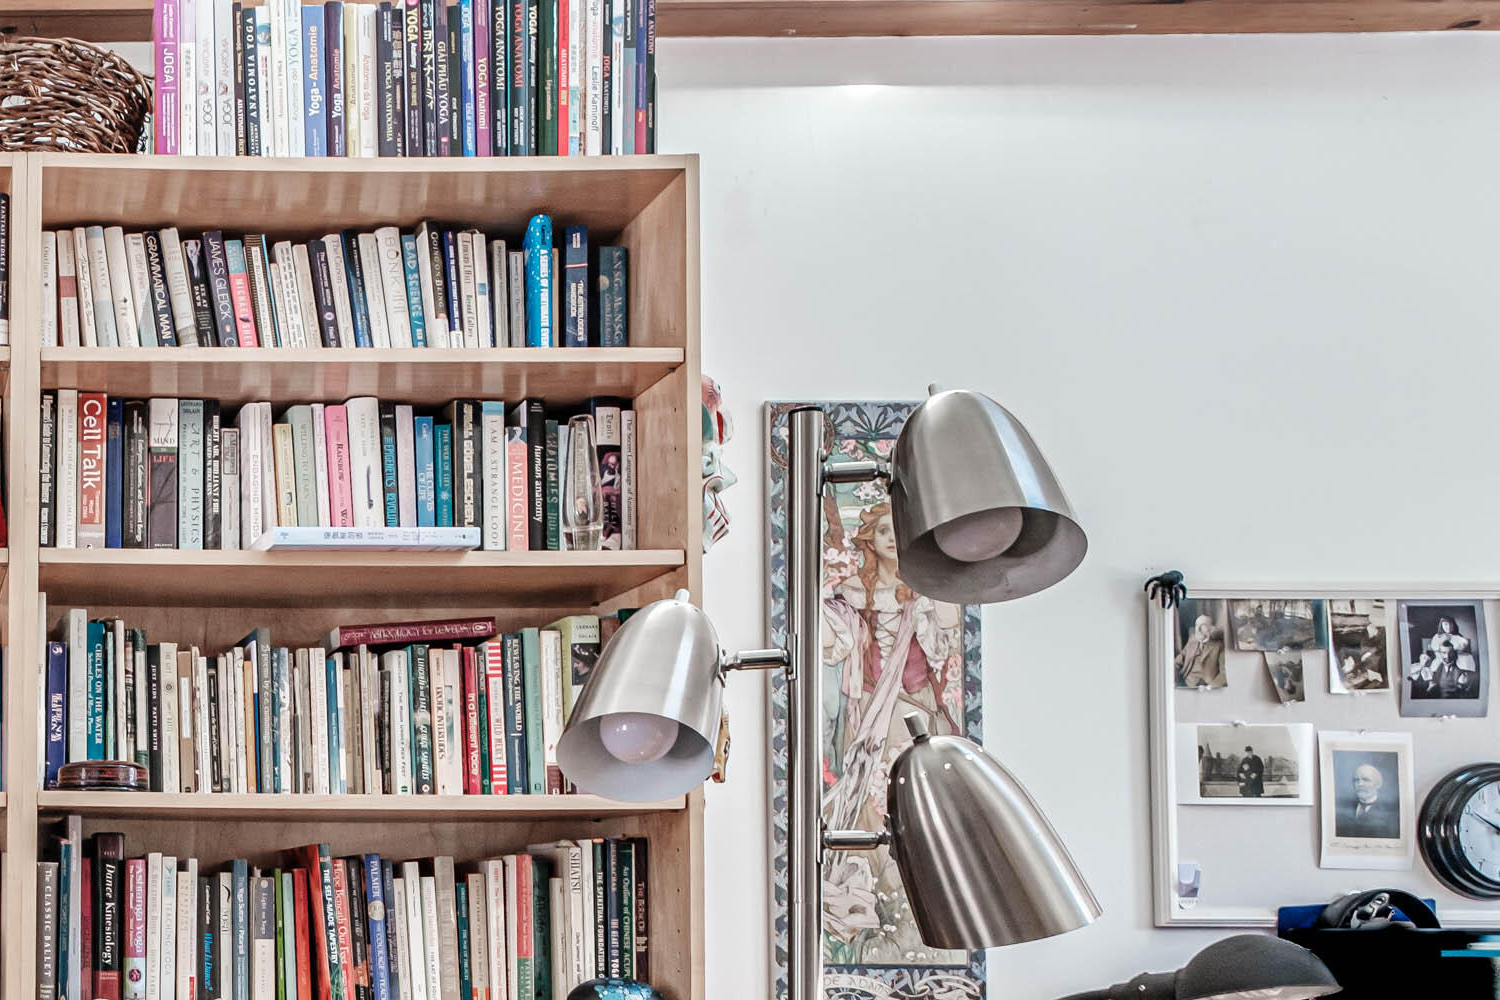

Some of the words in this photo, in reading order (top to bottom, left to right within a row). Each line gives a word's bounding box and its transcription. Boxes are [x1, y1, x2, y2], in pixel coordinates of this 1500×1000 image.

[496, 5, 504, 35] YOGA
[163, 48, 174, 83] JOGA
[477, 57, 486, 87] YOGA
[496, 39, 505, 90] ANATOMI
[591, 66, 599, 92] Leslie
[478, 91, 487, 129] Anatomi
[209, 238, 224, 275] JAMES
[384, 236, 400, 289] BONK
[404, 241, 415, 268] BAD
[147, 236, 166, 310] GRAMMATICAL
[159, 314, 172, 339] MAN
[216, 278, 231, 320] GLEICK
[408, 273, 422, 317] SCIENCE
[84, 399, 102, 440] Cell
[491, 428, 498, 443] AM
[190, 423, 200, 457] ART
[491, 448, 498, 456] A
[83, 444, 101, 488] Talk
[336, 443, 345, 480] RAINBOW
[384, 444, 396, 486] EPIGENETICS
[534, 445, 543, 478] human
[625, 454, 633, 485] Language
[491, 459, 499, 510] STRANGE
[512, 461, 525, 541] MEDICINE
[533, 480, 543, 522] anatomy
[191, 488, 200, 544] PHYSICS
[625, 496, 633, 526] Anatomy
[491, 515, 499, 547] LOOP
[95, 681, 102, 693] ON
[435, 686, 443, 713] EROTIC
[437, 715, 445, 759] INTERLUDES
[44, 868, 52, 883] The
[105, 863, 115, 898] Dance
[370, 860, 380, 898] PALMER
[570, 852, 581, 895] SHIATSU
[44, 885, 52, 931] CLASSIC
[324, 884, 334, 926] SELF-MADE
[103, 902, 115, 965] Kinesiology
[328, 928, 338, 965] TAPESTRY
